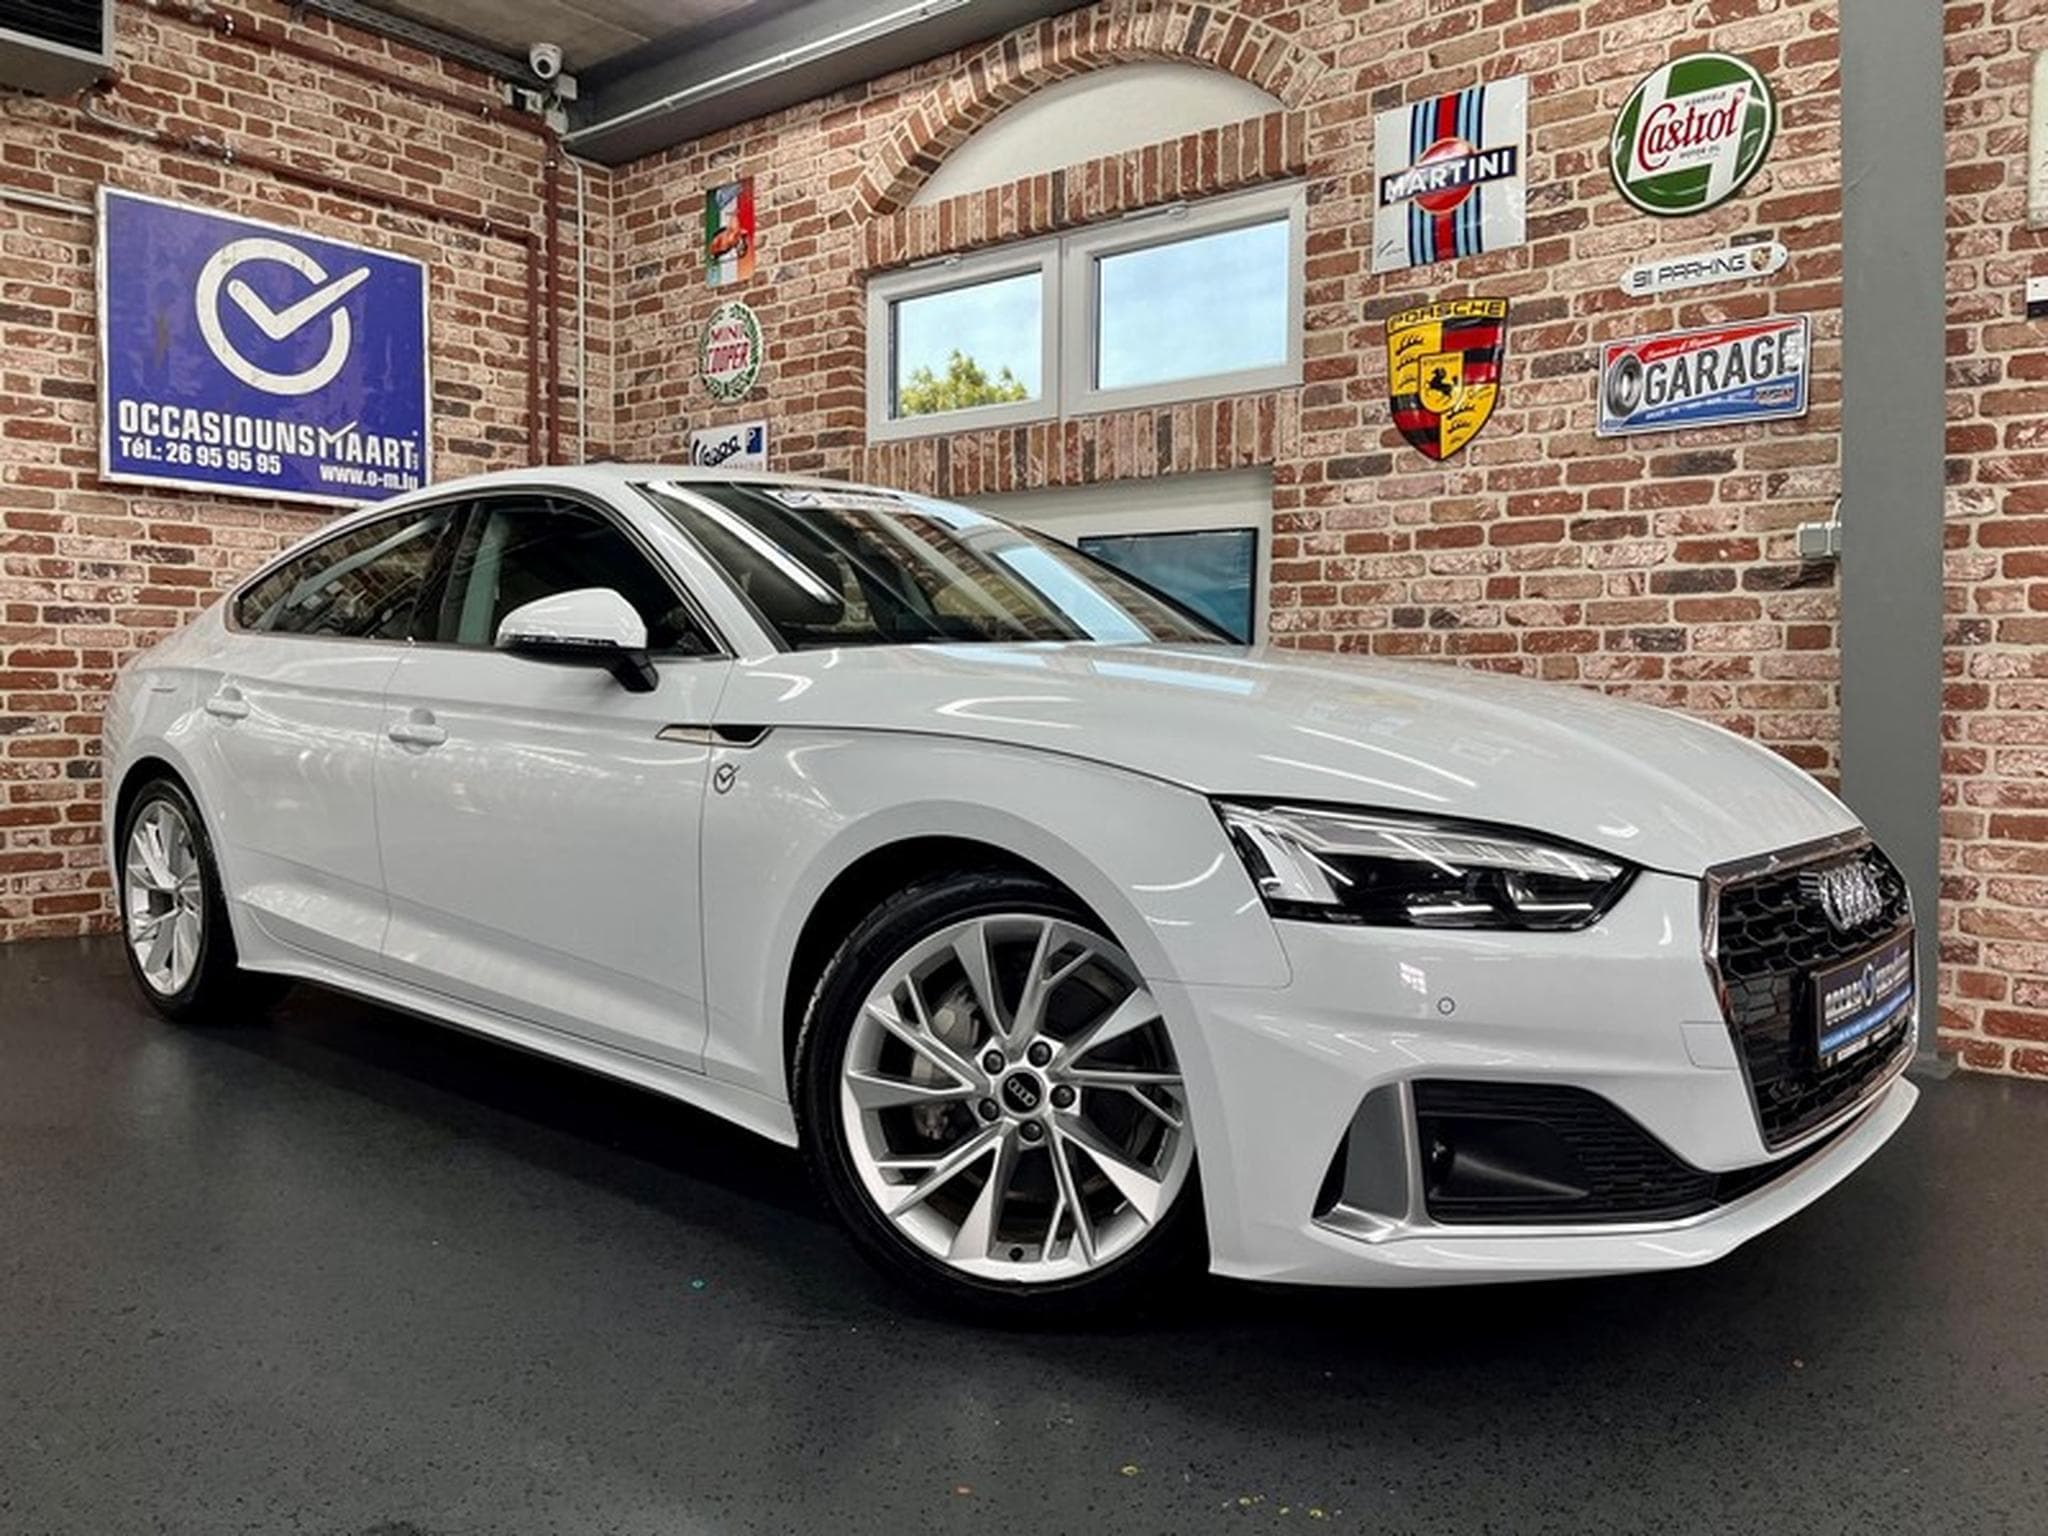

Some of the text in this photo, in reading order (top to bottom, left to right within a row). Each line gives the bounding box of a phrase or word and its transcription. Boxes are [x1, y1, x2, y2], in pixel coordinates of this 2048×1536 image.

[1637, 88, 1746, 172] Castrol
[1385, 150, 1510, 204] MARTINI
[1658, 253, 1746, 284] PARKING
[1389, 301, 1501, 331] PORSCHE
[1644, 328, 1801, 406] GARAGE
[118, 399, 416, 470] OCCASIOUNSMAART
[165, 440, 192, 464] 26
[196, 444, 222, 468] 95
[226, 449, 252, 472] 95
[256, 452, 281, 475] 95
[319, 463, 419, 491] www.o-m.lu
